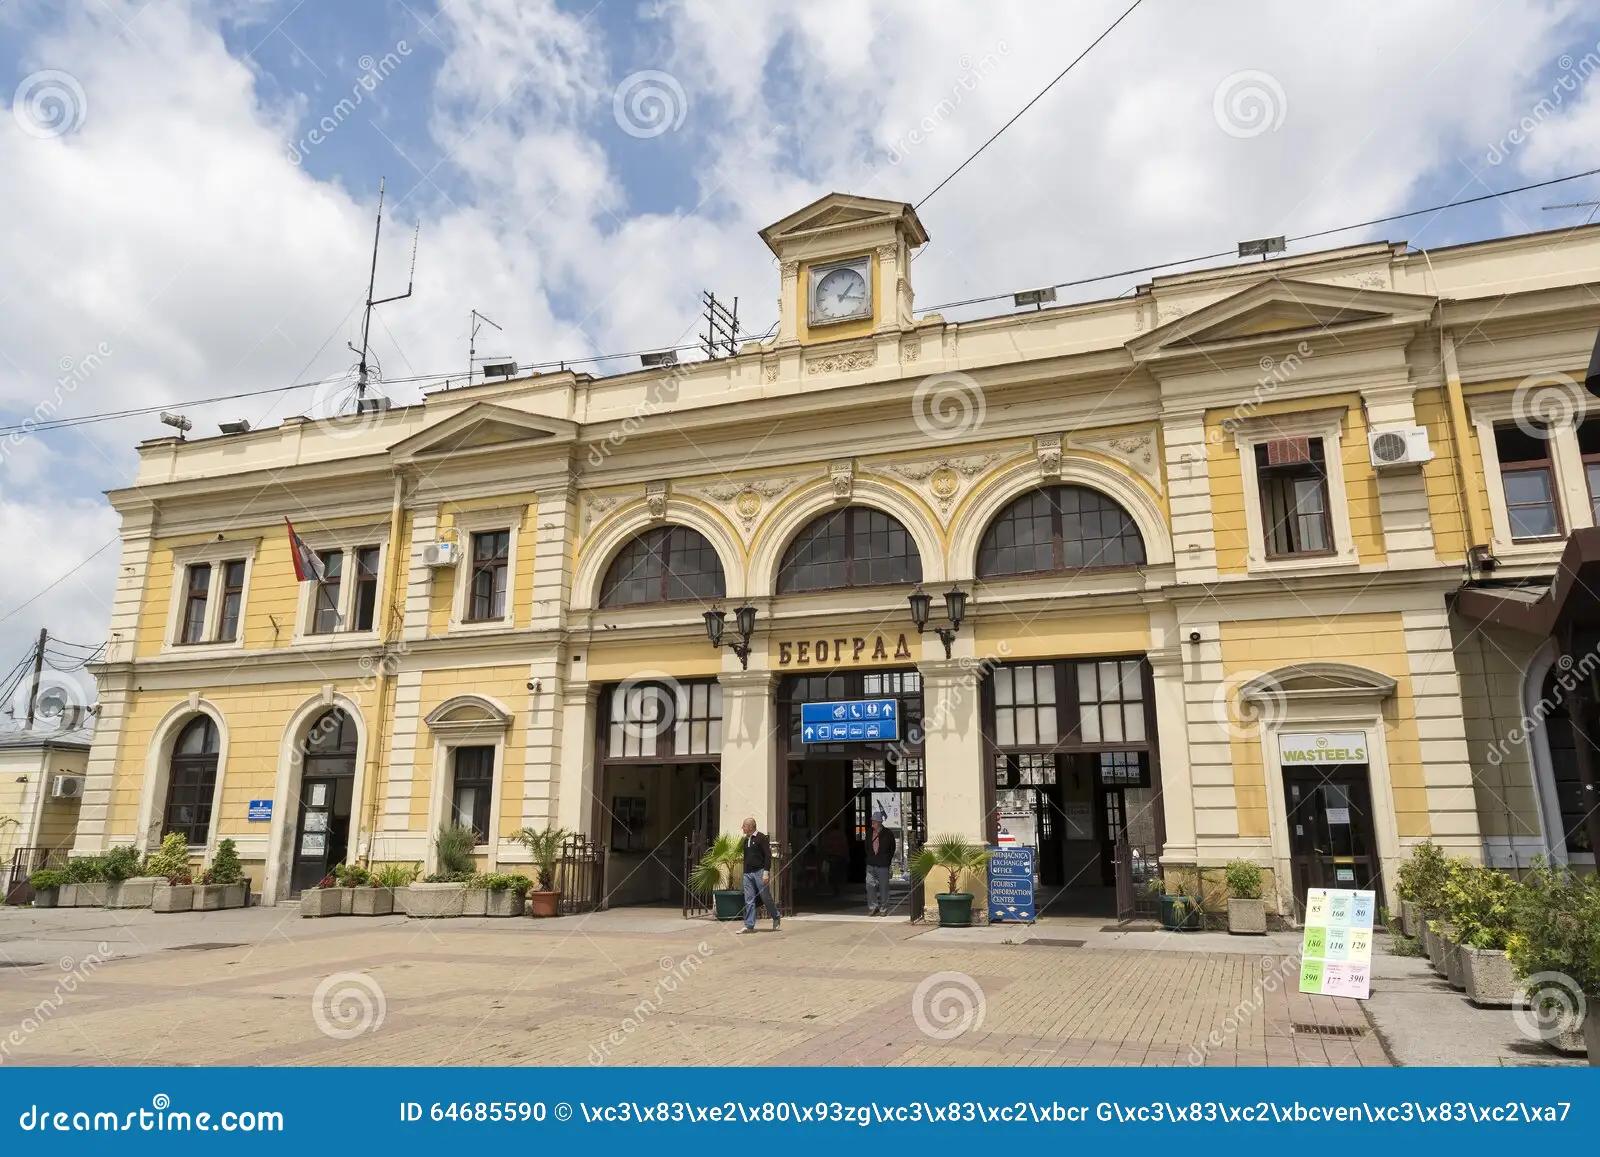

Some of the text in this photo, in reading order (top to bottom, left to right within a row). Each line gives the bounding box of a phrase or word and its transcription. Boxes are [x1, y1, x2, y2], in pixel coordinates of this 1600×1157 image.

[779, 633, 911, 664] БЕОГРАД
[1283, 748, 1364, 762] WASTEELS
[1312, 905, 1321, 913] 85
[1355, 909, 1366, 917] 80
[1331, 910, 1345, 918] 160
[1307, 939, 1321, 948] 180
[1329, 941, 1344, 950] 110
[1352, 942, 1366, 950] 120
[1304, 973, 1318, 982] 390
[1349, 974, 1364, 983] 390
